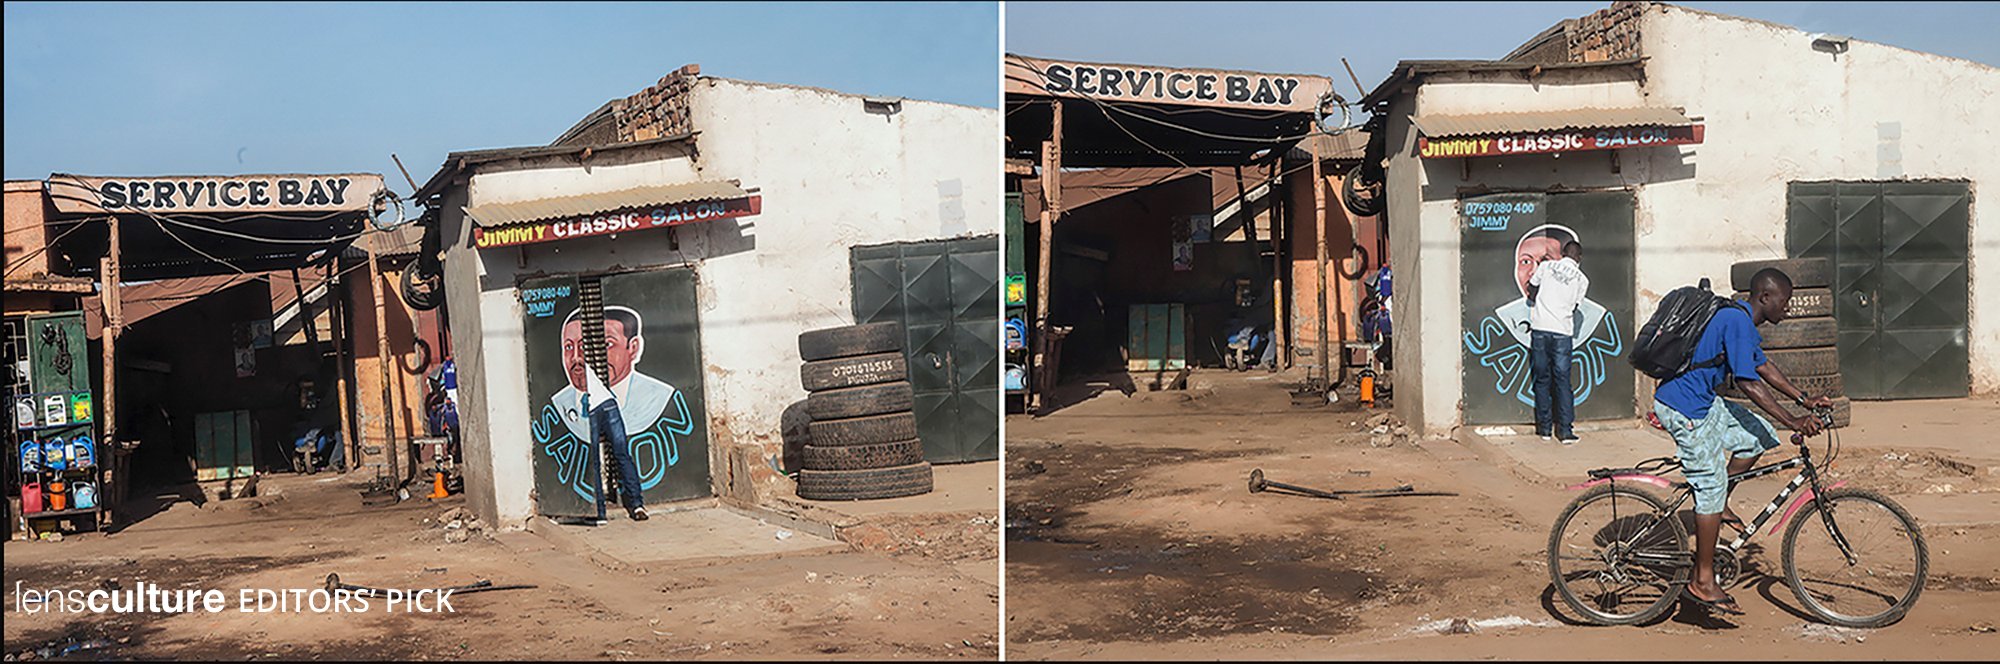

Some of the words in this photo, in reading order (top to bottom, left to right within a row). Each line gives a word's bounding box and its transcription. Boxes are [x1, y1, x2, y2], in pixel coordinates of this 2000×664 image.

[1045, 64, 1217, 101] SERVICE
[1225, 74, 1299, 106] BAY
[1421, 139, 1491, 158] JIMMY
[1497, 133, 1584, 153] CLASSIC
[1594, 128, 1669, 148] SALON
[100, 180, 271, 210] SERVICE
[277, 178, 350, 206] BAY
[477, 224, 547, 248] JIMMY
[552, 212, 640, 238] CLASSIC
[650, 202, 725, 226] SALON
[1469, 215, 1511, 229] JIMMY
[527, 300, 556, 315] JIMMY
